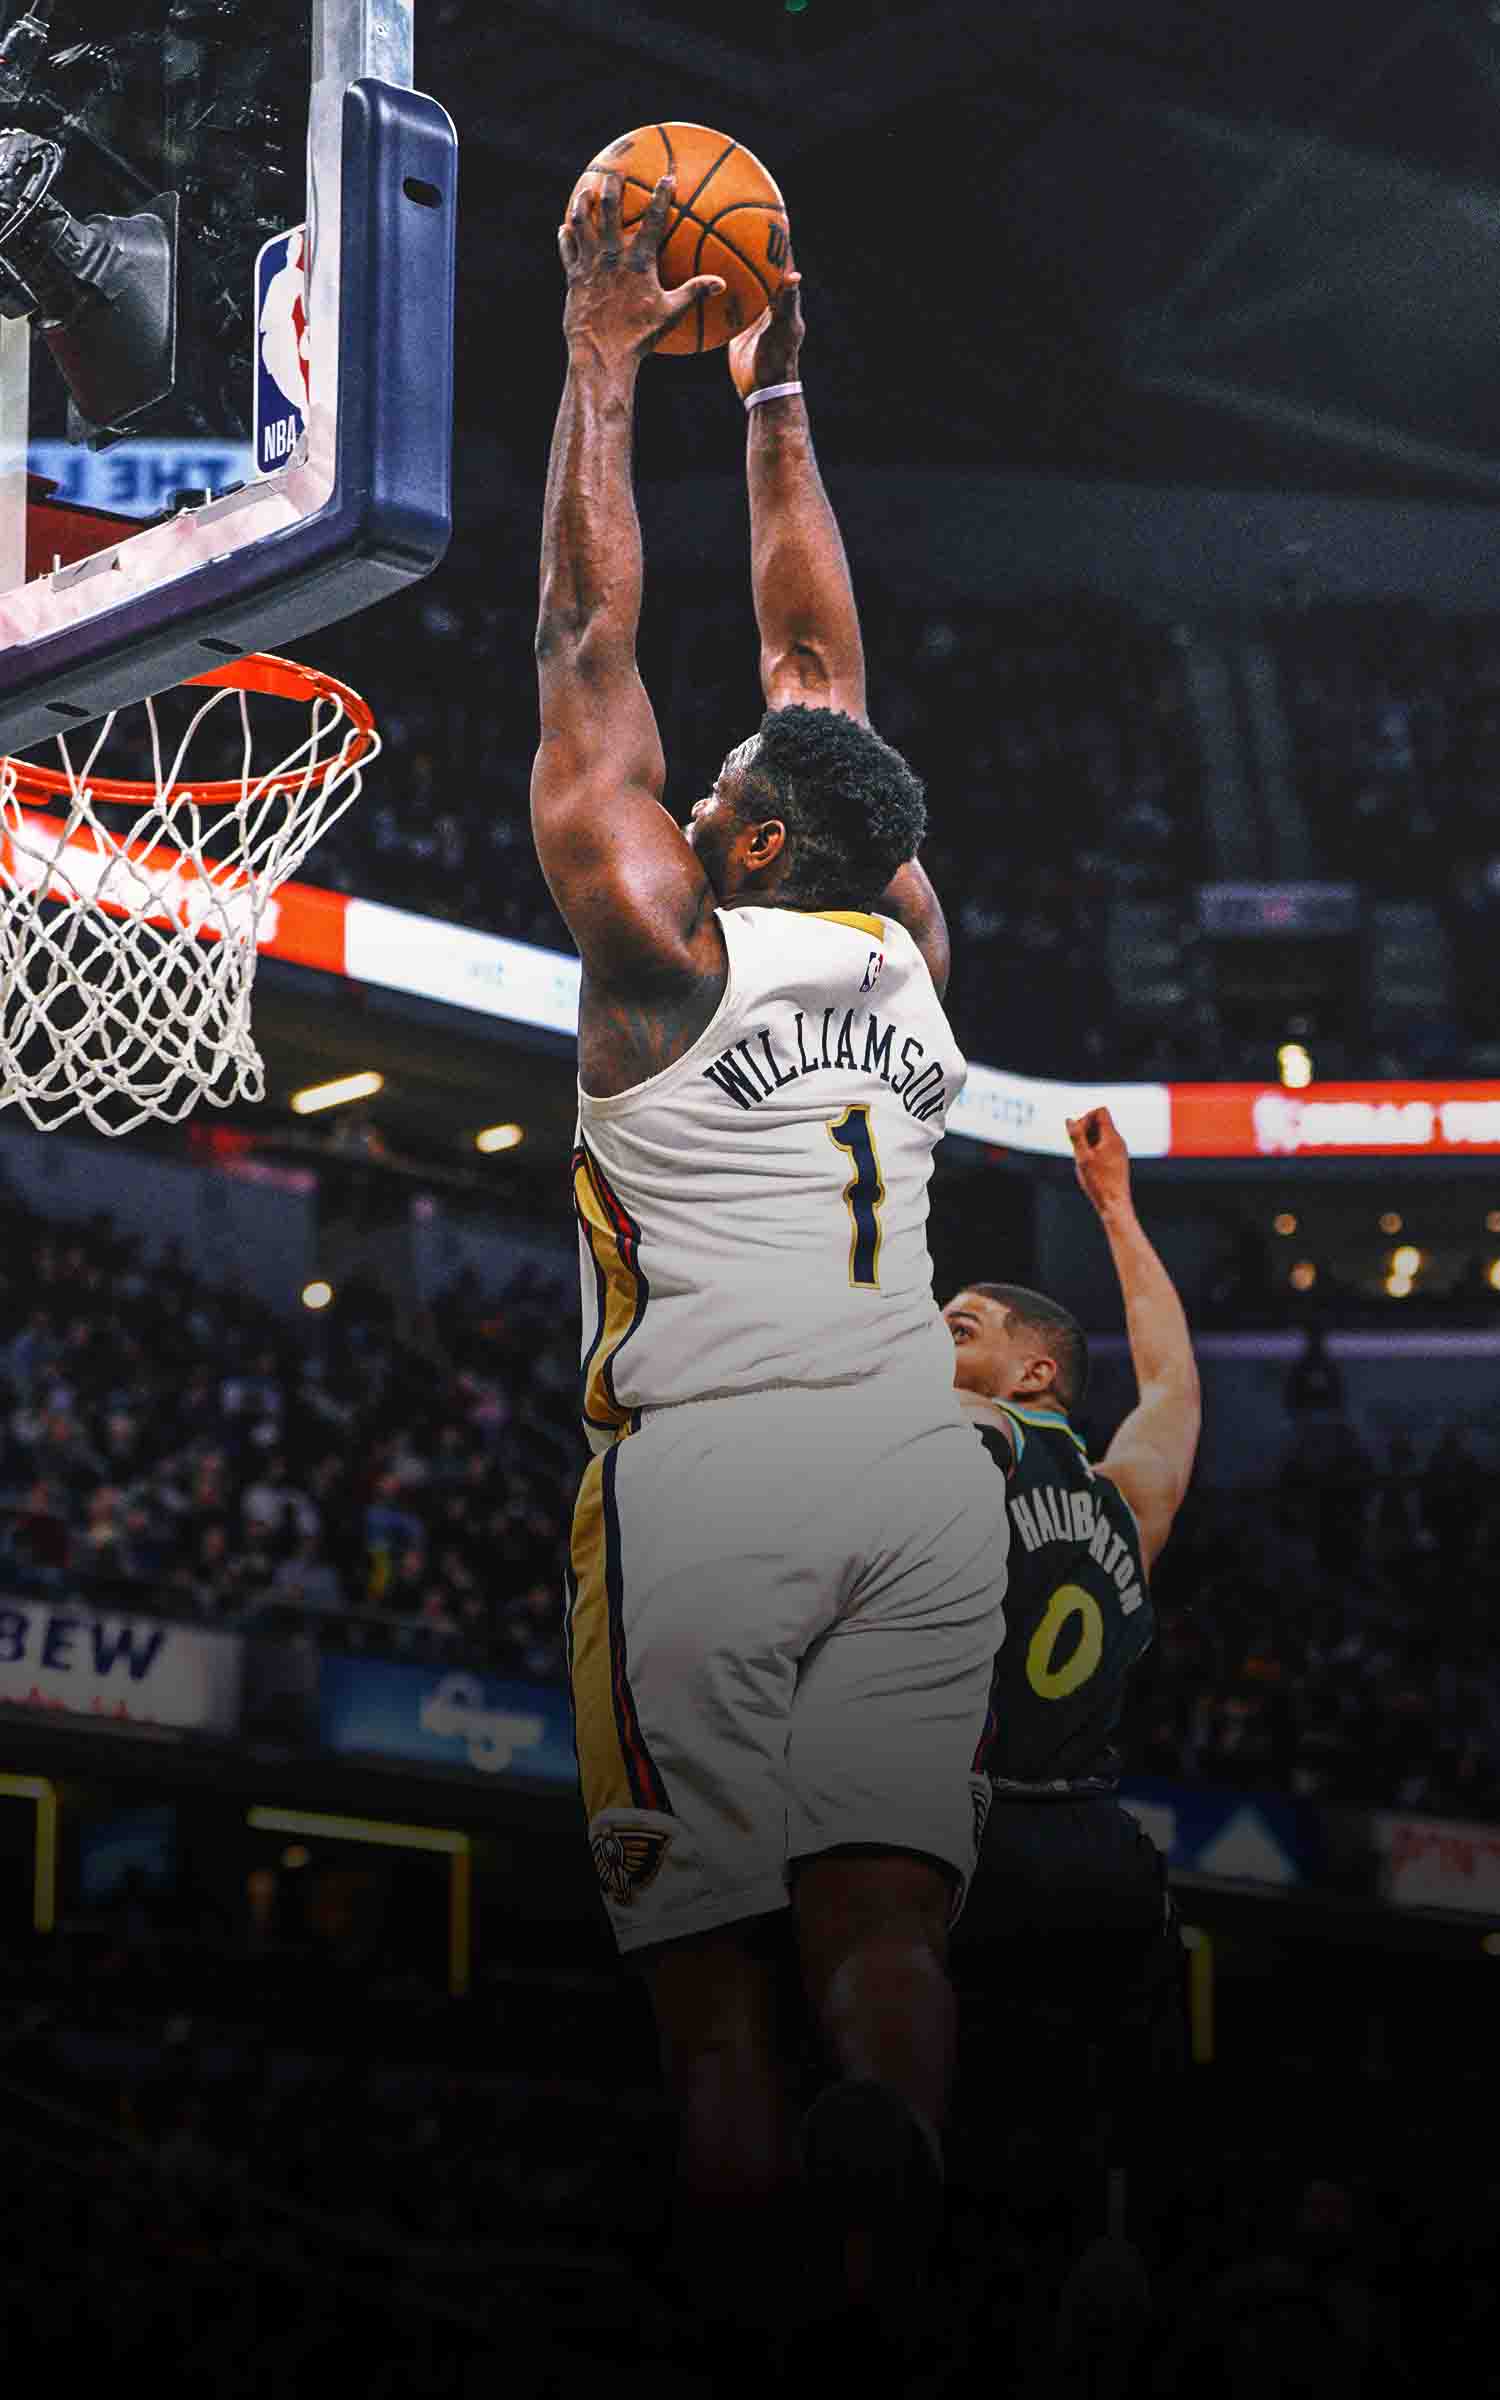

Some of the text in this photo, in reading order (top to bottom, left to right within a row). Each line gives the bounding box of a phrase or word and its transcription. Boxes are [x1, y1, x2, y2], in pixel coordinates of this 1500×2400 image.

[264, 414, 297, 463] NBA
[702, 1007, 945, 1121] WILLIAMSON
[825, 1104, 885, 1289] 1
[1009, 1485, 1143, 1616] HALIBRTON
[1026, 1584, 1103, 1700] 0
